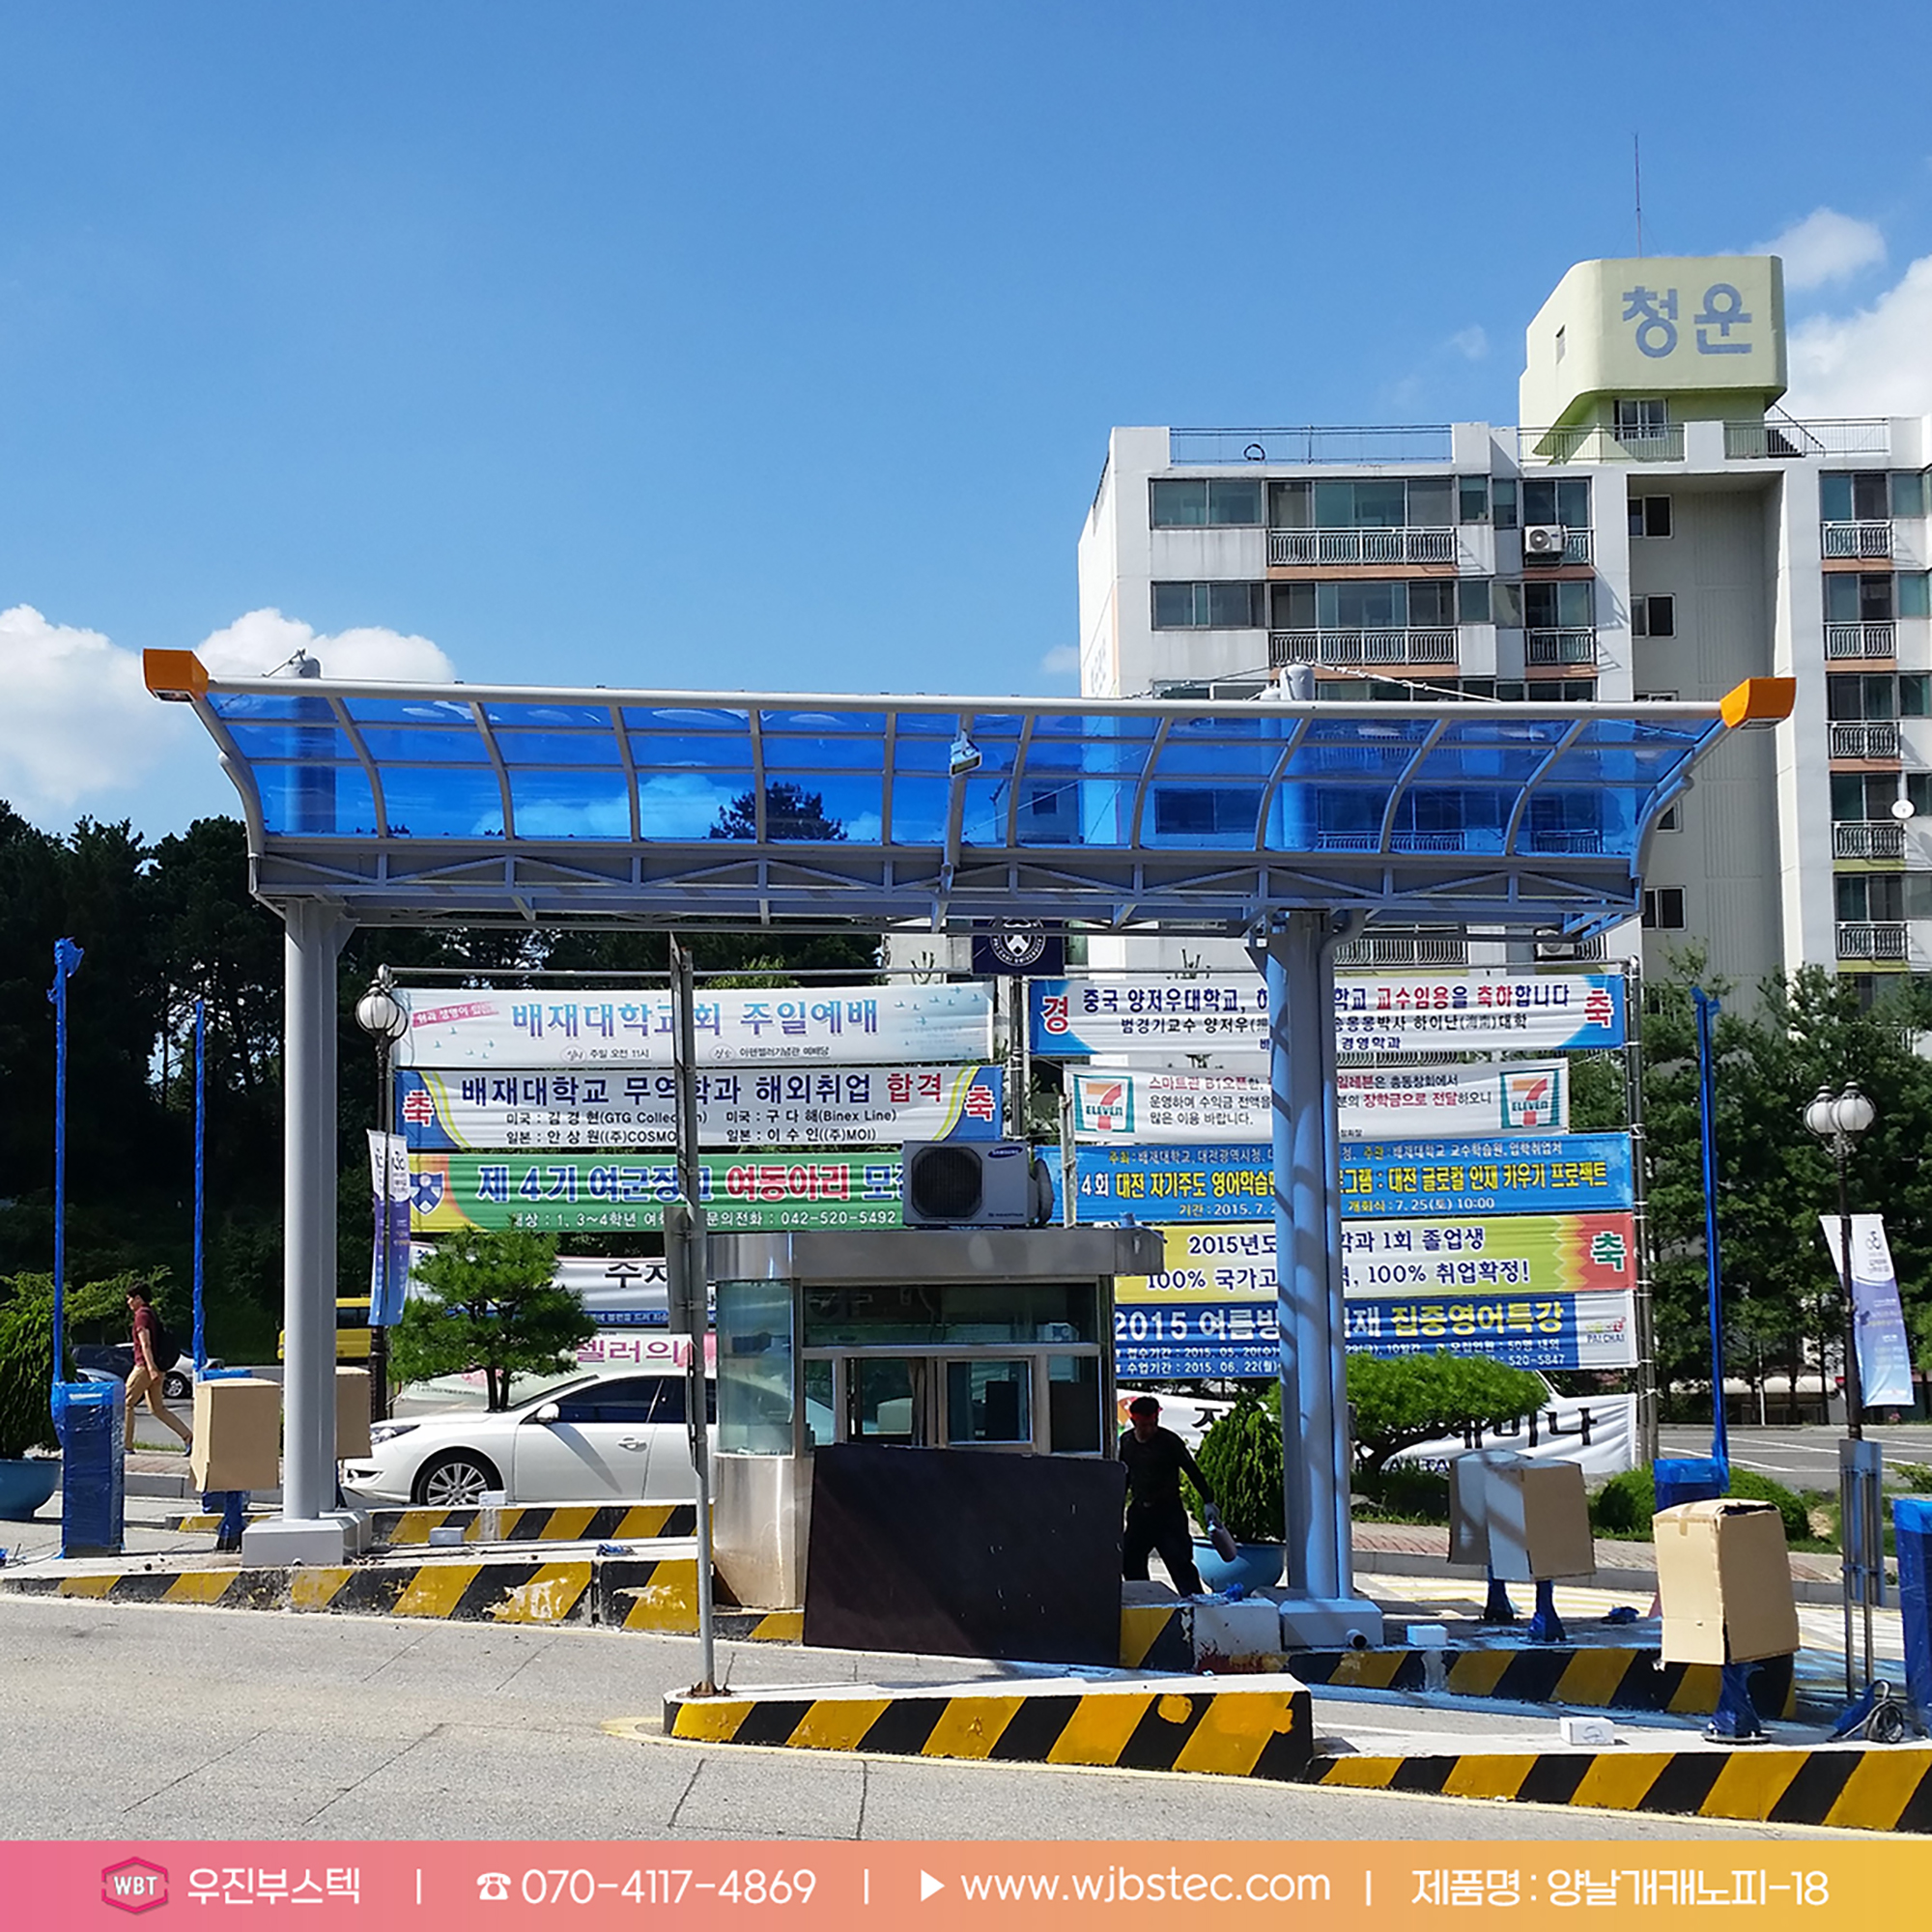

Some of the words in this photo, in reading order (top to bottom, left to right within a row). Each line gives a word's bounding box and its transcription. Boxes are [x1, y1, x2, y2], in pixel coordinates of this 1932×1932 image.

[1622, 283, 1752, 358] 청운
[1083, 988, 1119, 1012] 중국
[1128, 987, 1245, 1014] 양저우대학교,
[1377, 985, 1467, 1010] 교수임용을
[1477, 984, 1569, 1008] 축하합니다
[1585, 990, 1611, 1027] 축
[512, 1001, 721, 1037] 배재대학교회
[740, 999, 877, 1036] 주일예배
[1043, 997, 1068, 1032] 경
[1121, 1018, 1197, 1034] 범경기교수
[1204, 1017, 1268, 1033] 양저우(
[590, 1049, 608, 1059] 주일
[611, 1049, 628, 1059] 오전
[632, 1049, 649, 1059] 11시
[1342, 1037, 1401, 1050] 경영학과
[462, 1076, 609, 1107] 배재대학교
[624, 1074, 742, 1106] 무역학과
[755, 1074, 870, 1104] 해외취업
[887, 1072, 942, 1103] 합격
[1149, 1076, 1200, 1091] 스마트관
[404, 1092, 433, 1126] 축
[966, 1087, 994, 1121] 축
[1200, 1095, 1233, 1109] 수익금
[1363, 1093, 1427, 1109] 장학금으로
[1432, 1091, 1492, 1107] 전달하오니
[506, 1112, 531, 1125] 미국
[638, 1111, 707, 1124] Collecn)
[726, 1109, 751, 1122] 미국
[766, 1109, 781, 1122] 구
[865, 1109, 896, 1123] Line)
[1177, 1111, 1200, 1125] 이용
[1204, 1111, 1254, 1125] 바랍니다.
[506, 1130, 531, 1145] 일본
[586, 1129, 676, 1145] 원((주)COSMO
[726, 1128, 751, 1143] 일본
[477, 1165, 509, 1202] 제
[520, 1165, 578, 1202] 4기
[726, 1164, 850, 1201] 여동아리
[1081, 1173, 1109, 1197] 4회
[1116, 1172, 1145, 1198] 대전
[1151, 1171, 1207, 1198] 자기주도
[1388, 1167, 1417, 1193] 대전
[1469, 1164, 1498, 1190] 인재
[1503, 1163, 1546, 1189] 키우기
[1551, 1161, 1607, 1187] 프로젝트
[1458, 1197, 1495, 1210] 10:00
[706, 1211, 762, 1227] 문의전화
[781, 1210, 895, 1225] 042-520-5492
[1189, 1235, 1276, 1256] 2015년도
[1383, 1230, 1412, 1252] 1회
[1421, 1227, 1485, 1252] 졸업생
[1593, 1234, 1625, 1270] 축
[1148, 1270, 1206, 1289] 100%
[1215, 1267, 1276, 1290] 국가고
[1368, 1264, 1427, 1283] 100%
[1435, 1261, 1530, 1285] 취업확정!
[1115, 1311, 1188, 1341] 2015
[1198, 1308, 1280, 1341] 여름방
[1390, 1300, 1564, 1337] 집중영어특강
[1127, 1362, 1172, 1375] 수업기간
[1184, 1362, 1215, 1374] 2015.
[1508, 1353, 1565, 1366] 520-5847
